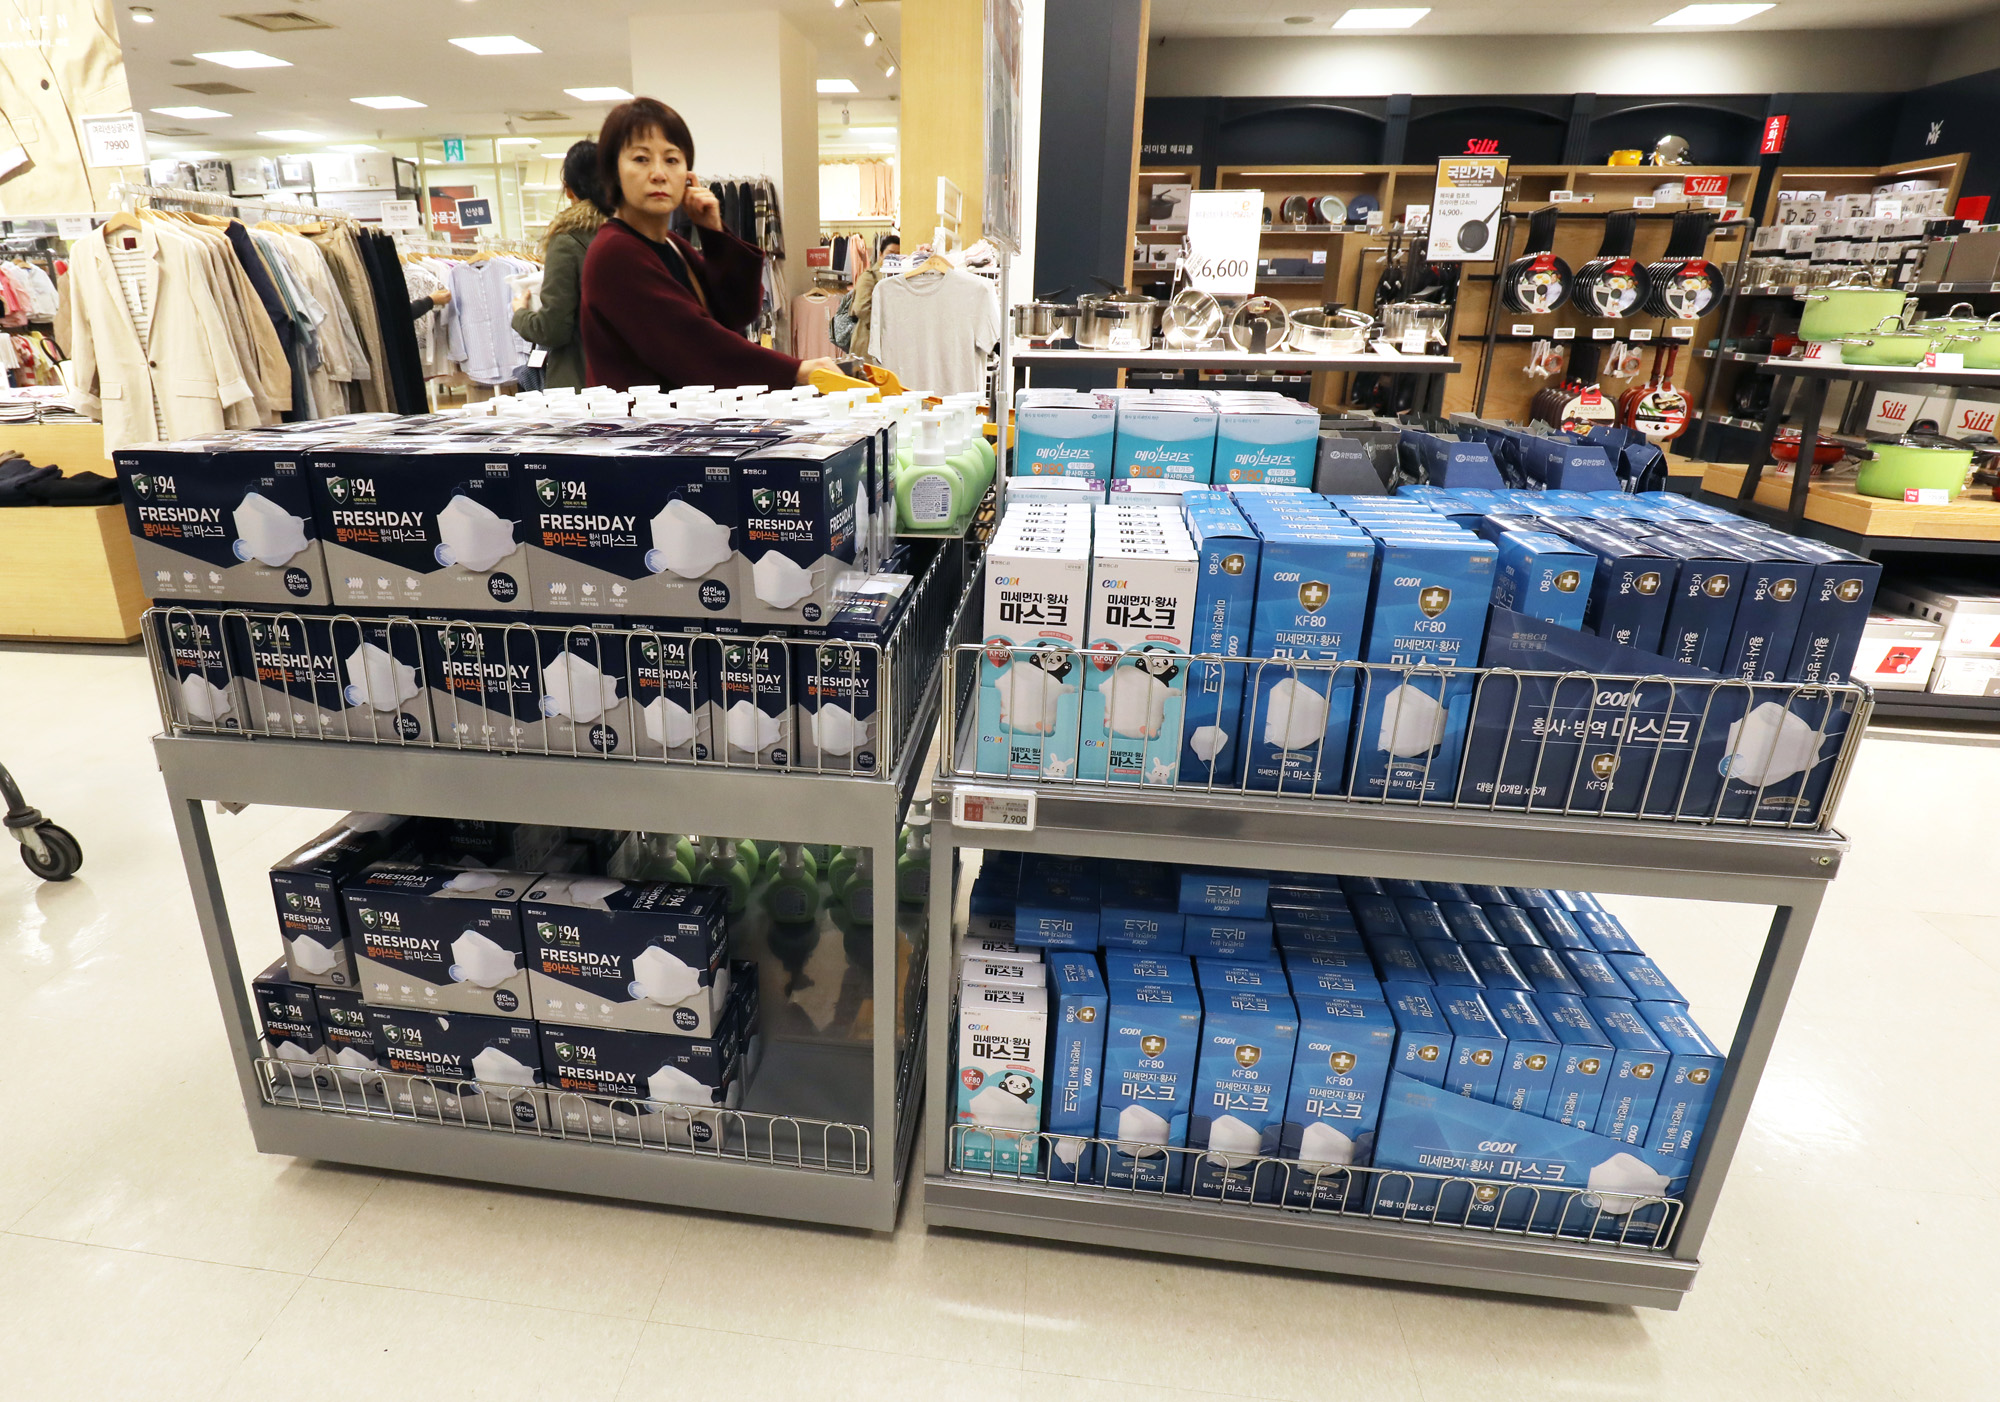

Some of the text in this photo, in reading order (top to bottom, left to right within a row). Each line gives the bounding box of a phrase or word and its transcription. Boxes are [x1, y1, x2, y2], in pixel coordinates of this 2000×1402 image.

[1765, 118, 1780, 151] 소화기
[1926, 120, 1944, 145] WMF
[104, 140, 129, 149] 79900
[1463, 139, 1499, 154] Silit
[1448, 166, 1495, 179] 국민가격
[1687, 178, 1723, 193] Silit
[465, 207, 484, 216] 신상품
[1196, 259, 1248, 280] 6,600
[1877, 400, 1908, 421] Silit
[1957, 410, 1995, 432] Silit
[1036, 443, 1090, 459] 메이브리즈
[1135, 445, 1190, 462] 메이브리즈
[1235, 448, 1292, 466] 메이브리즈
[1264, 476, 1296, 484] 황사마스크
[139, 507, 220, 523] FRESHDAY
[332, 511, 423, 526] FRESHDAY
[540, 514, 636, 531] FRESHDAY
[143, 523, 225, 537] 뽑아쓰는 마스크
[748, 519, 813, 530] FRESHDAY
[336, 528, 427, 542] 뽑아쓰는 마스크
[543, 532, 638, 547] 뽑아쓰는 마스크
[749, 531, 813, 541] 뽑아쓰는 마스크
[1208, 553, 1219, 575] KF80
[995, 576, 1020, 586] CODI
[1102, 580, 1127, 589] CODI
[1274, 572, 1300, 582] CODI
[1394, 577, 1422, 587] CODI
[1539, 569, 1554, 592] KF80
[1620, 571, 1633, 595] KF94
[1688, 573, 1702, 598] KF94
[1754, 577, 1769, 602] KF94
[1820, 578, 1835, 602] KF94
[1001, 591, 1068, 604] 미세먼지·황사
[1108, 594, 1177, 607] 미세먼지·황사
[1000, 604, 1067, 626] 마스크
[1106, 607, 1175, 629] 마스크
[1295, 615, 1327, 627] KF80
[1414, 620, 1446, 633] KF80
[1276, 633, 1341, 646] 미세먼지·황사
[1394, 638, 1461, 652] 미세먼지·황사
[255, 653, 333, 669] FRESHDAY
[443, 661, 530, 679] FRESHDAY
[638, 668, 698, 681] FRESHDAY
[720, 671, 781, 684] FRESHDAY
[758, 684, 781, 694] 마스크
[807, 675, 869, 688] FRESHDAY
[1596, 691, 1642, 707] CODI
[1612, 716, 1690, 744] 마스크
[1476, 782, 1493, 792] 대형
[370, 872, 434, 883] FRESHDAY
[283, 912, 330, 925] FRESHDAY
[314, 923, 331, 932] 마스크
[364, 933, 440, 951] FRESHDAY
[367, 947, 442, 962] 뽑아쓰는 마스크
[540, 948, 621, 967] FRESHDAY
[543, 961, 622, 978] 뽑아쓰는 마스크
[1066, 1006, 1074, 1023] KF80
[267, 1021, 311, 1032] FRESHDAY
[328, 1027, 372, 1038] FRESHDAY
[968, 1023, 989, 1031] CODI
[1120, 1027, 1142, 1036] CODI
[973, 1034, 1031, 1046] 미세먼지·황사
[1213, 1037, 1236, 1045] CODI
[1308, 1042, 1331, 1051] CODI
[387, 1048, 461, 1065] FRESHDAY
[972, 1044, 1030, 1061] 마스크
[1405, 1043, 1417, 1061] KF80
[1459, 1048, 1471, 1065] KF80
[1139, 1059, 1164, 1069] KF80
[1513, 1052, 1524, 1070] KF80
[1566, 1057, 1577, 1073] KF80
[436, 1064, 463, 1075] 마스크
[558, 1066, 636, 1084] FRESHDAY
[1083, 1067, 1093, 1086] CODI
[1232, 1069, 1258, 1080] KF80
[1620, 1061, 1631, 1078] KF80
[1675, 1067, 1687, 1084] KF80
[964, 1076, 980, 1084] KF80
[1123, 1072, 1177, 1083] 미세먼지·황사
[1326, 1076, 1353, 1086] KF80
[560, 1078, 638, 1095] 뽑아쓰는 마스크
[1121, 1084, 1175, 1101] 마스크
[1216, 1081, 1270, 1094] 미세먼지·황사
[1213, 1092, 1269, 1112] 마스크
[1309, 1088, 1365, 1101] 미세먼지·황사
[1306, 1099, 1362, 1120] 마스크
[1477, 1140, 1518, 1154] CODI
[1679, 1129, 1692, 1150] CODI
[1419, 1154, 1566, 1181] 미세먼지·황사 마스크
[1379, 1200, 1394, 1209] 대형
[1470, 1203, 1495, 1213] KF80
